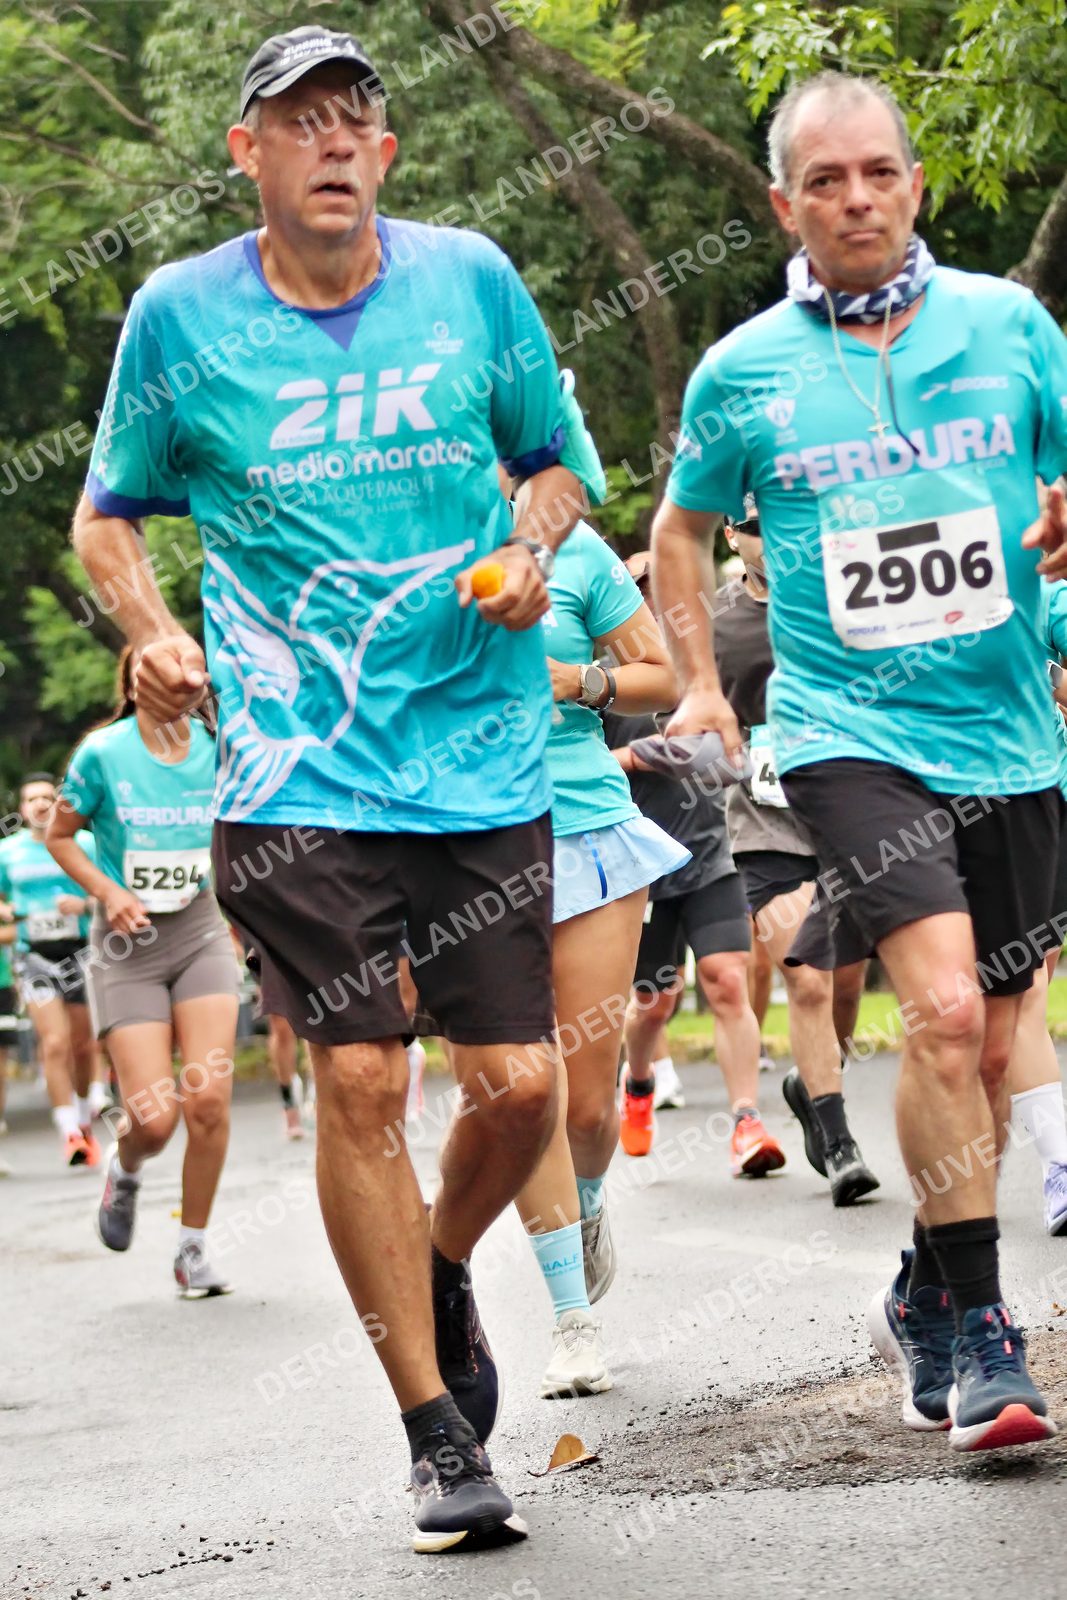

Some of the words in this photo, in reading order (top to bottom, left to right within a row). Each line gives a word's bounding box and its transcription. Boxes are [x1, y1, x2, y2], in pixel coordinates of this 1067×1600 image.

[270, 363, 443, 450] 21K
[246, 451, 347, 489] medio
[774, 413, 1016, 490] PERDURA
[841, 540, 994, 611] 2906
[132, 864, 204, 890] 5294
